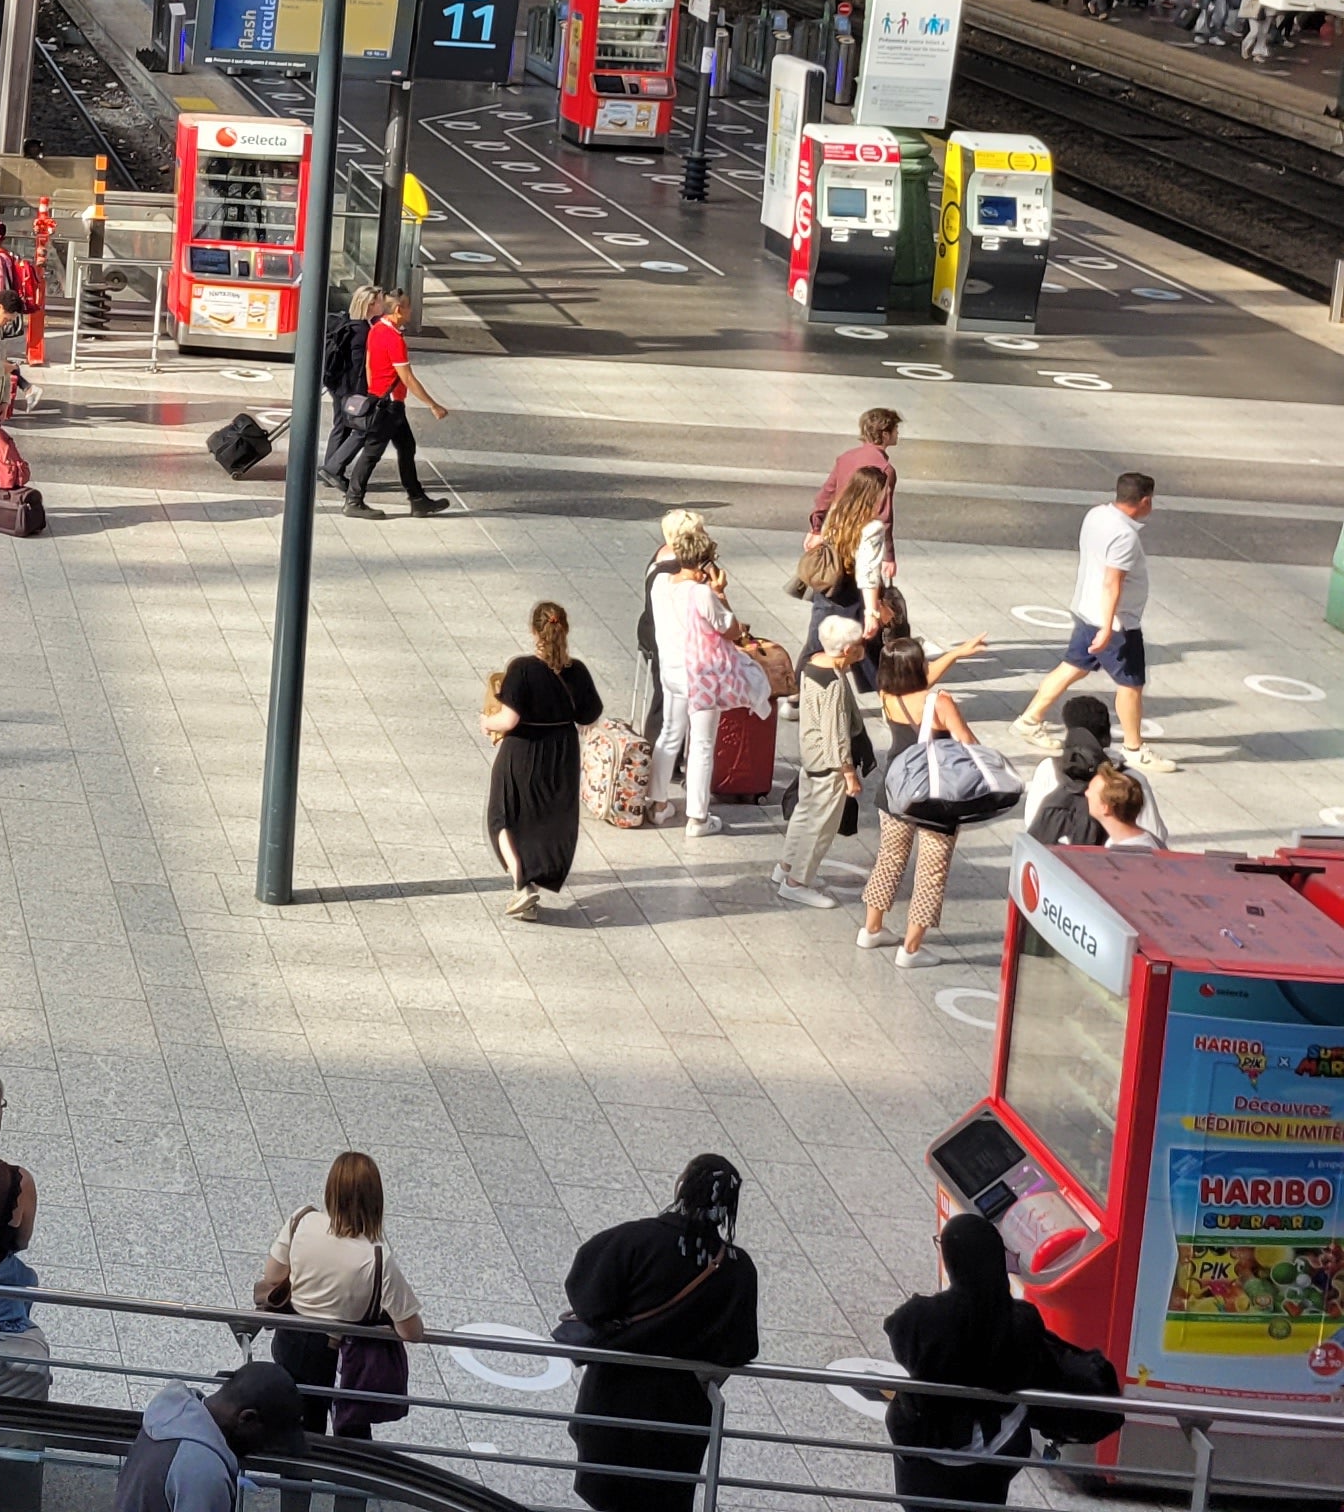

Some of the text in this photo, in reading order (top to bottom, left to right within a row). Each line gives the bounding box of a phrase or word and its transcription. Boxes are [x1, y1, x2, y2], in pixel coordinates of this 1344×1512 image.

[237, 9, 257, 50] flash
[442, 3, 495, 42] 11
[240, 134, 287, 146] selecta
[1042, 897, 1097, 958] selecta
[1216, 990, 1249, 998] selecta
[1194, 1036, 1263, 1055] HARIBO
[1234, 1096, 1331, 1117] Découvrez
[1194, 1113, 1280, 1136] L'ÉDITION
[1200, 1176, 1333, 1207] HARIBO
[1203, 1212, 1324, 1231] SUPER MARIO
